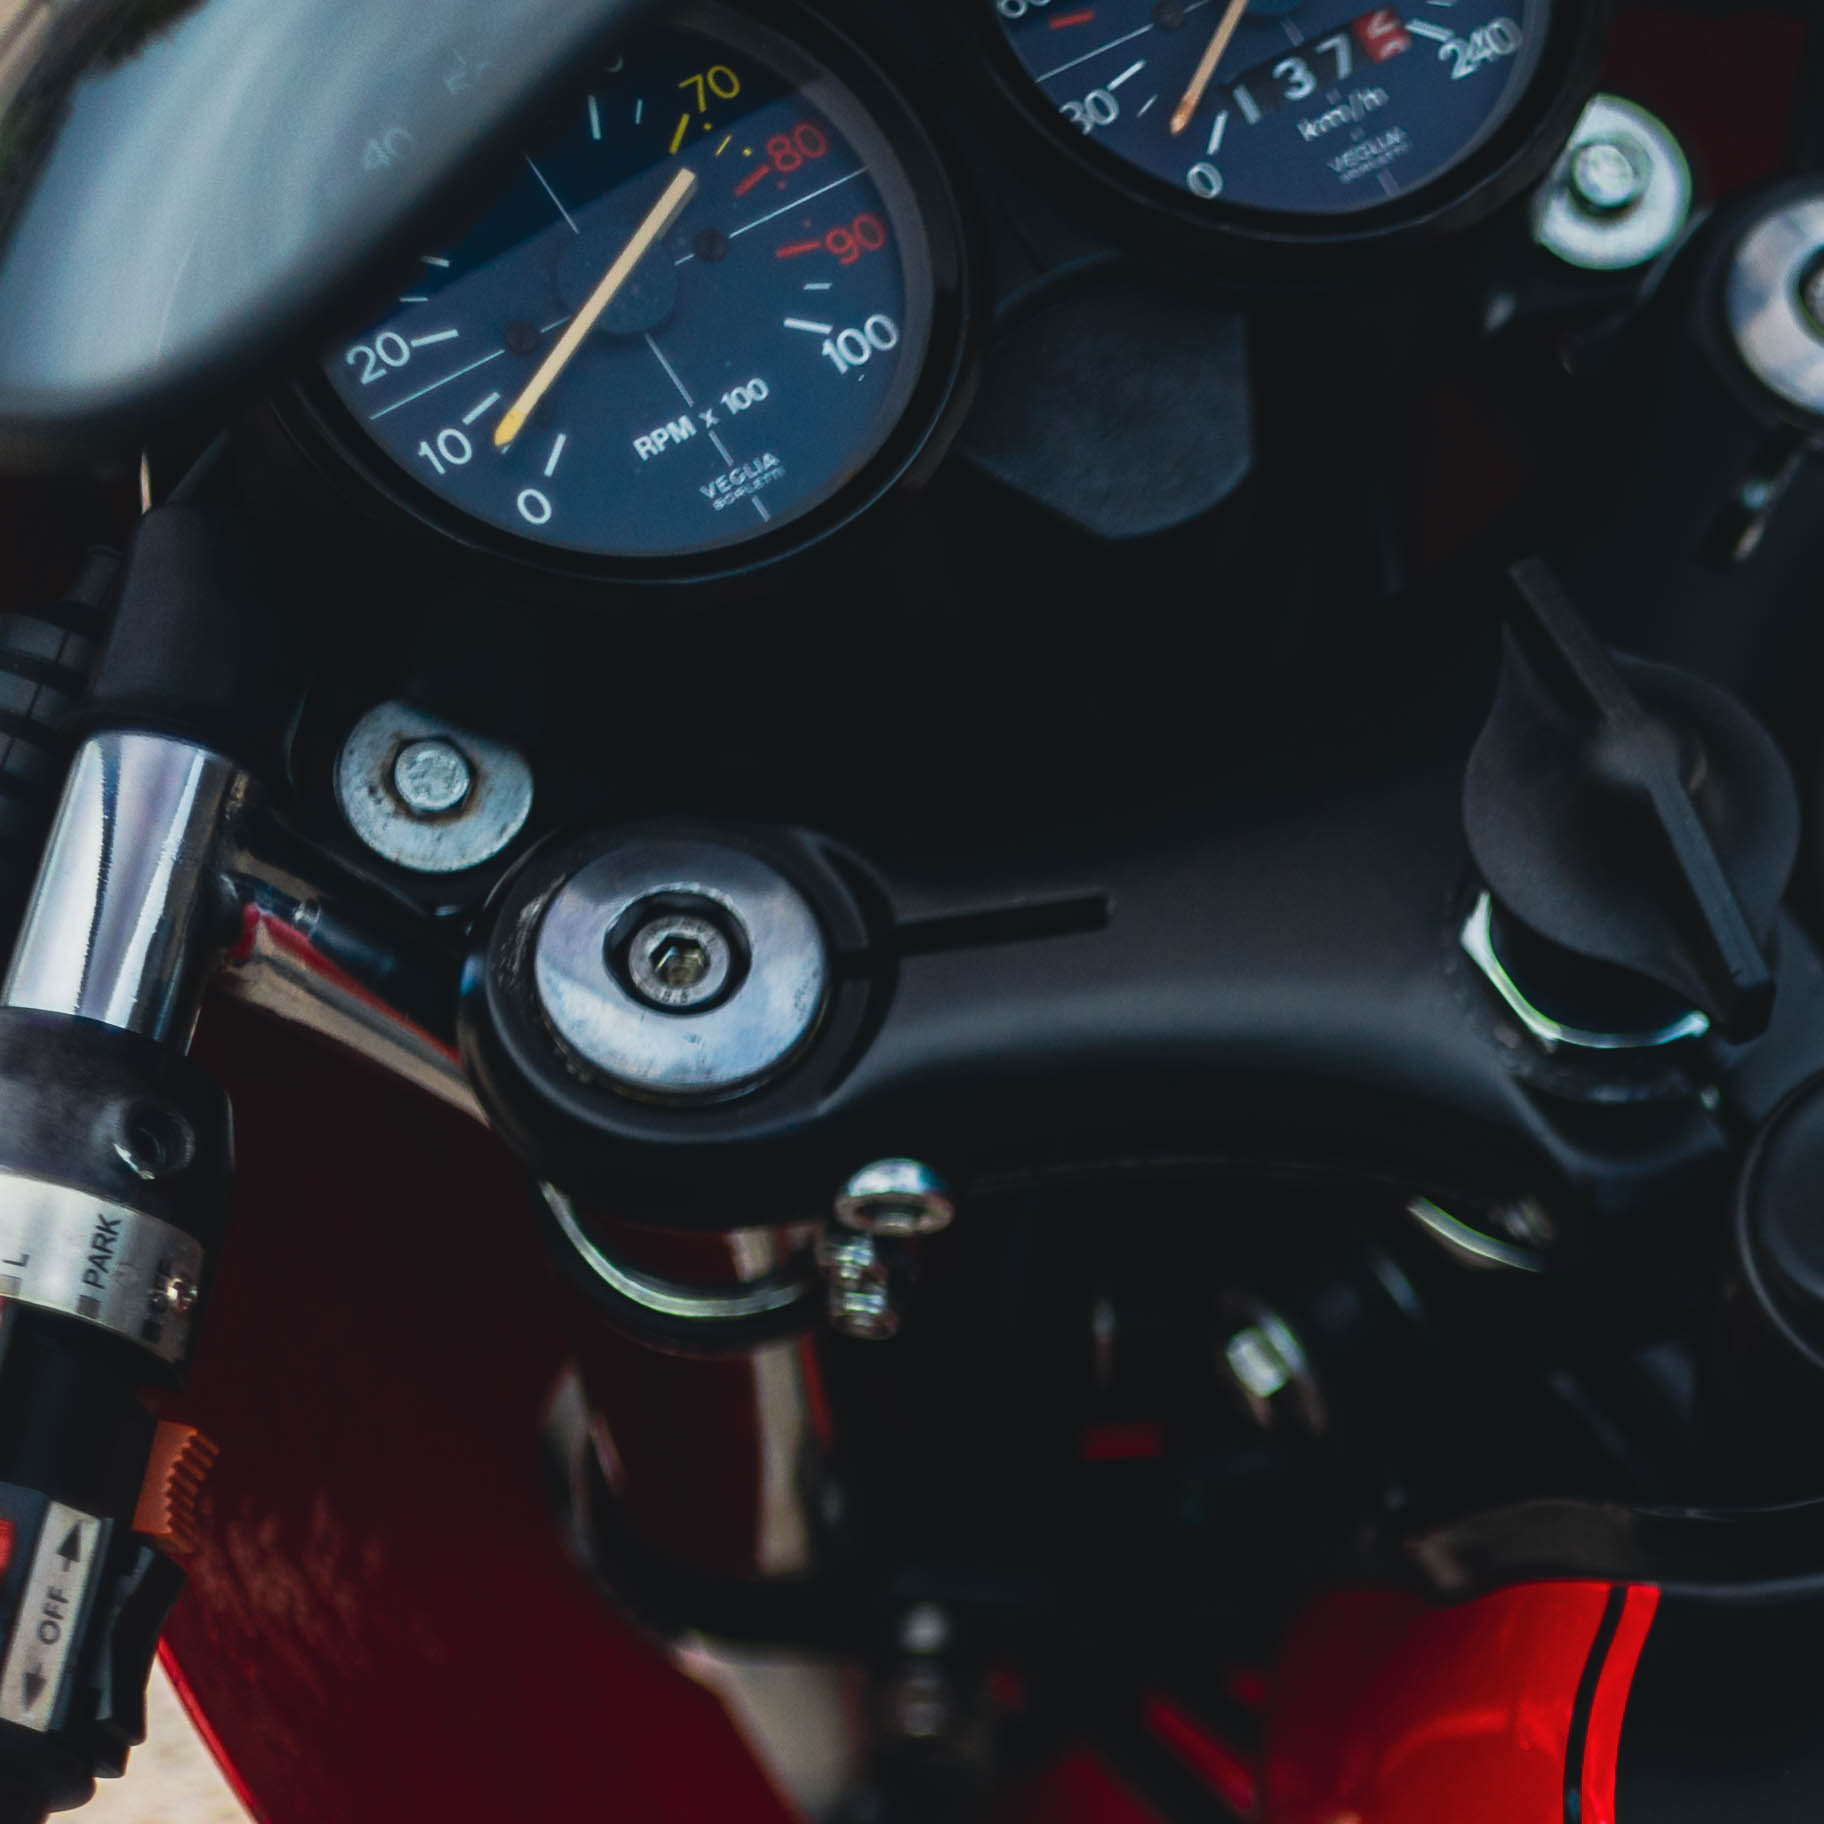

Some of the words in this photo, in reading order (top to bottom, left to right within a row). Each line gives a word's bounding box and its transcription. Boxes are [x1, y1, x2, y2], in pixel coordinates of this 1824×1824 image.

[1438, 16, 1522, 80] 240
[679, 64, 741, 113] 70
[1059, 86, 1120, 134] 30
[1296, 87, 1390, 142] km/h
[766, 122, 828, 172] 80
[1186, 161, 1223, 199] 0
[824, 213, 886, 265] 90
[346, 330, 411, 384] 20
[820, 313, 899, 375] 100
[632, 414, 697, 461] RPM
[720, 377, 770, 417] 100
[418, 427, 472, 475] 10
[699, 450, 781, 500] VEGLIA
[517, 488, 552, 524] 0
[82, 1214, 122, 1290] PARK
[38, 1585, 69, 1645] OFF
